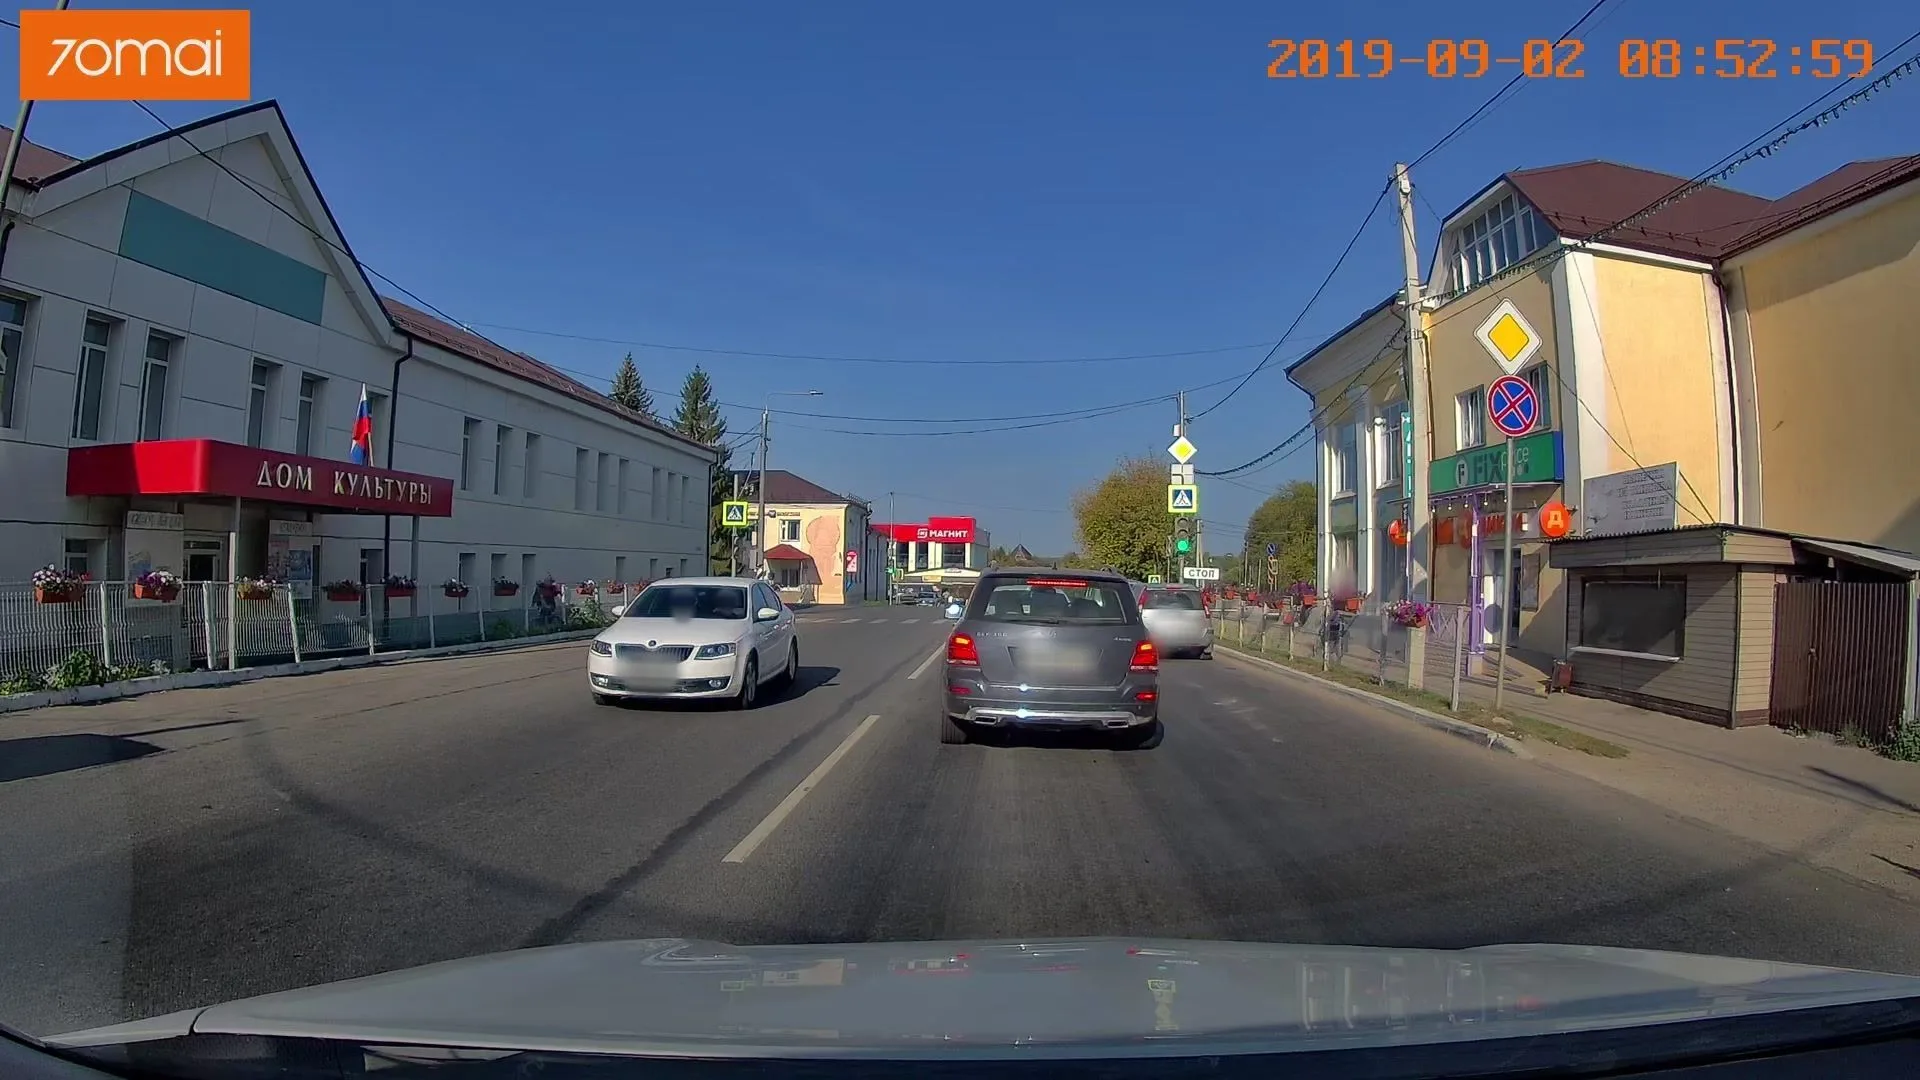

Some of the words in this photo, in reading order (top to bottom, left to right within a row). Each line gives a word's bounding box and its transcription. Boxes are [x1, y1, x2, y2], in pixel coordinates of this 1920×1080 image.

[1500, 446, 1529, 471] pce
[257, 460, 313, 491] ДОМ
[333, 470, 432, 505] КУЛЬТУРЫ
[1547, 510, 1564, 529] Д
[929, 529, 968, 538] МАГНИТ
[1188, 569, 1215, 578] СТОП
